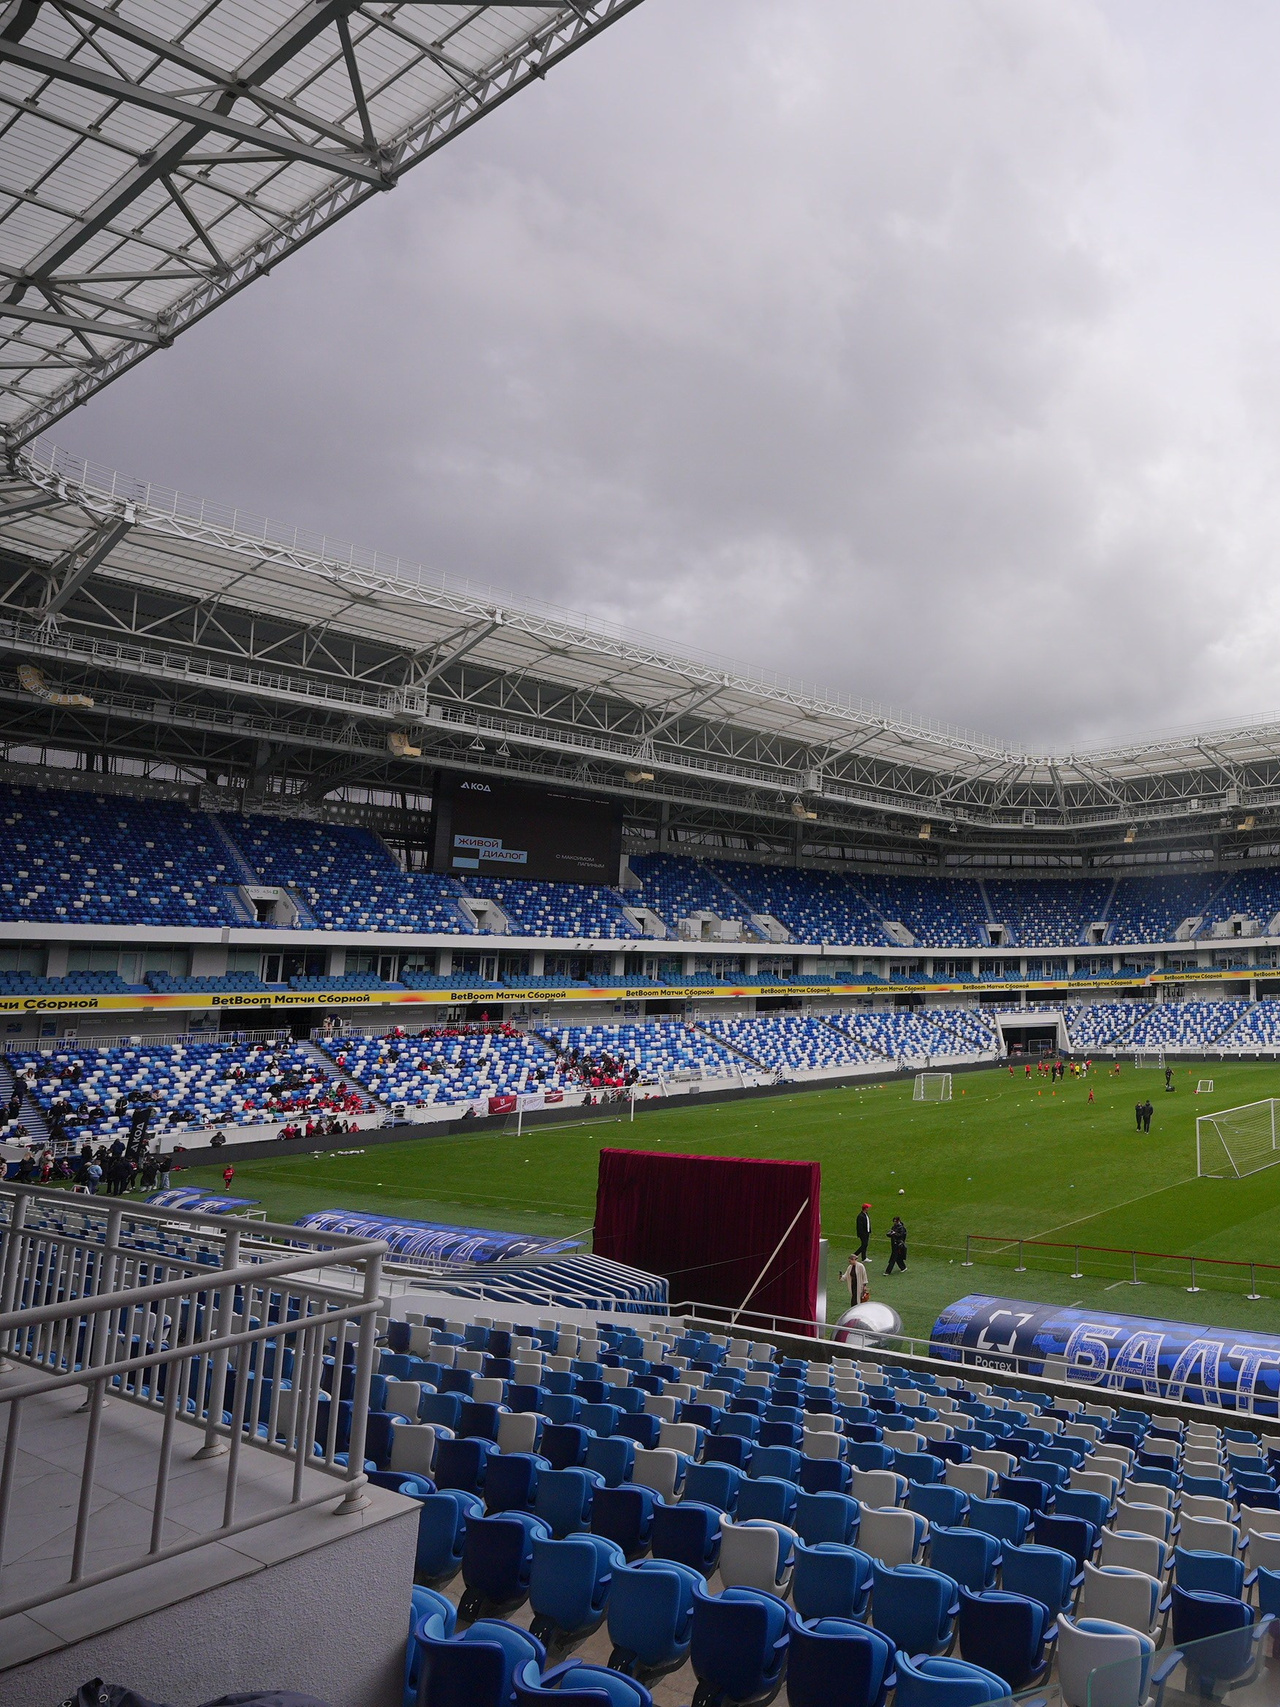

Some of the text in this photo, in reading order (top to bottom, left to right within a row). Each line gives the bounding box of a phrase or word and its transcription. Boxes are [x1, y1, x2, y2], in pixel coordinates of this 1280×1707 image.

[458, 838, 499, 848] ЖИВОЙ
[482, 850, 524, 860] ДИАЛОГ
[275, 995, 314, 1003] Матчи
[318, 994, 370, 1003] Сборной
[24, 999, 98, 1009] Сборной
[975, 1355, 1012, 1372] Ростех
